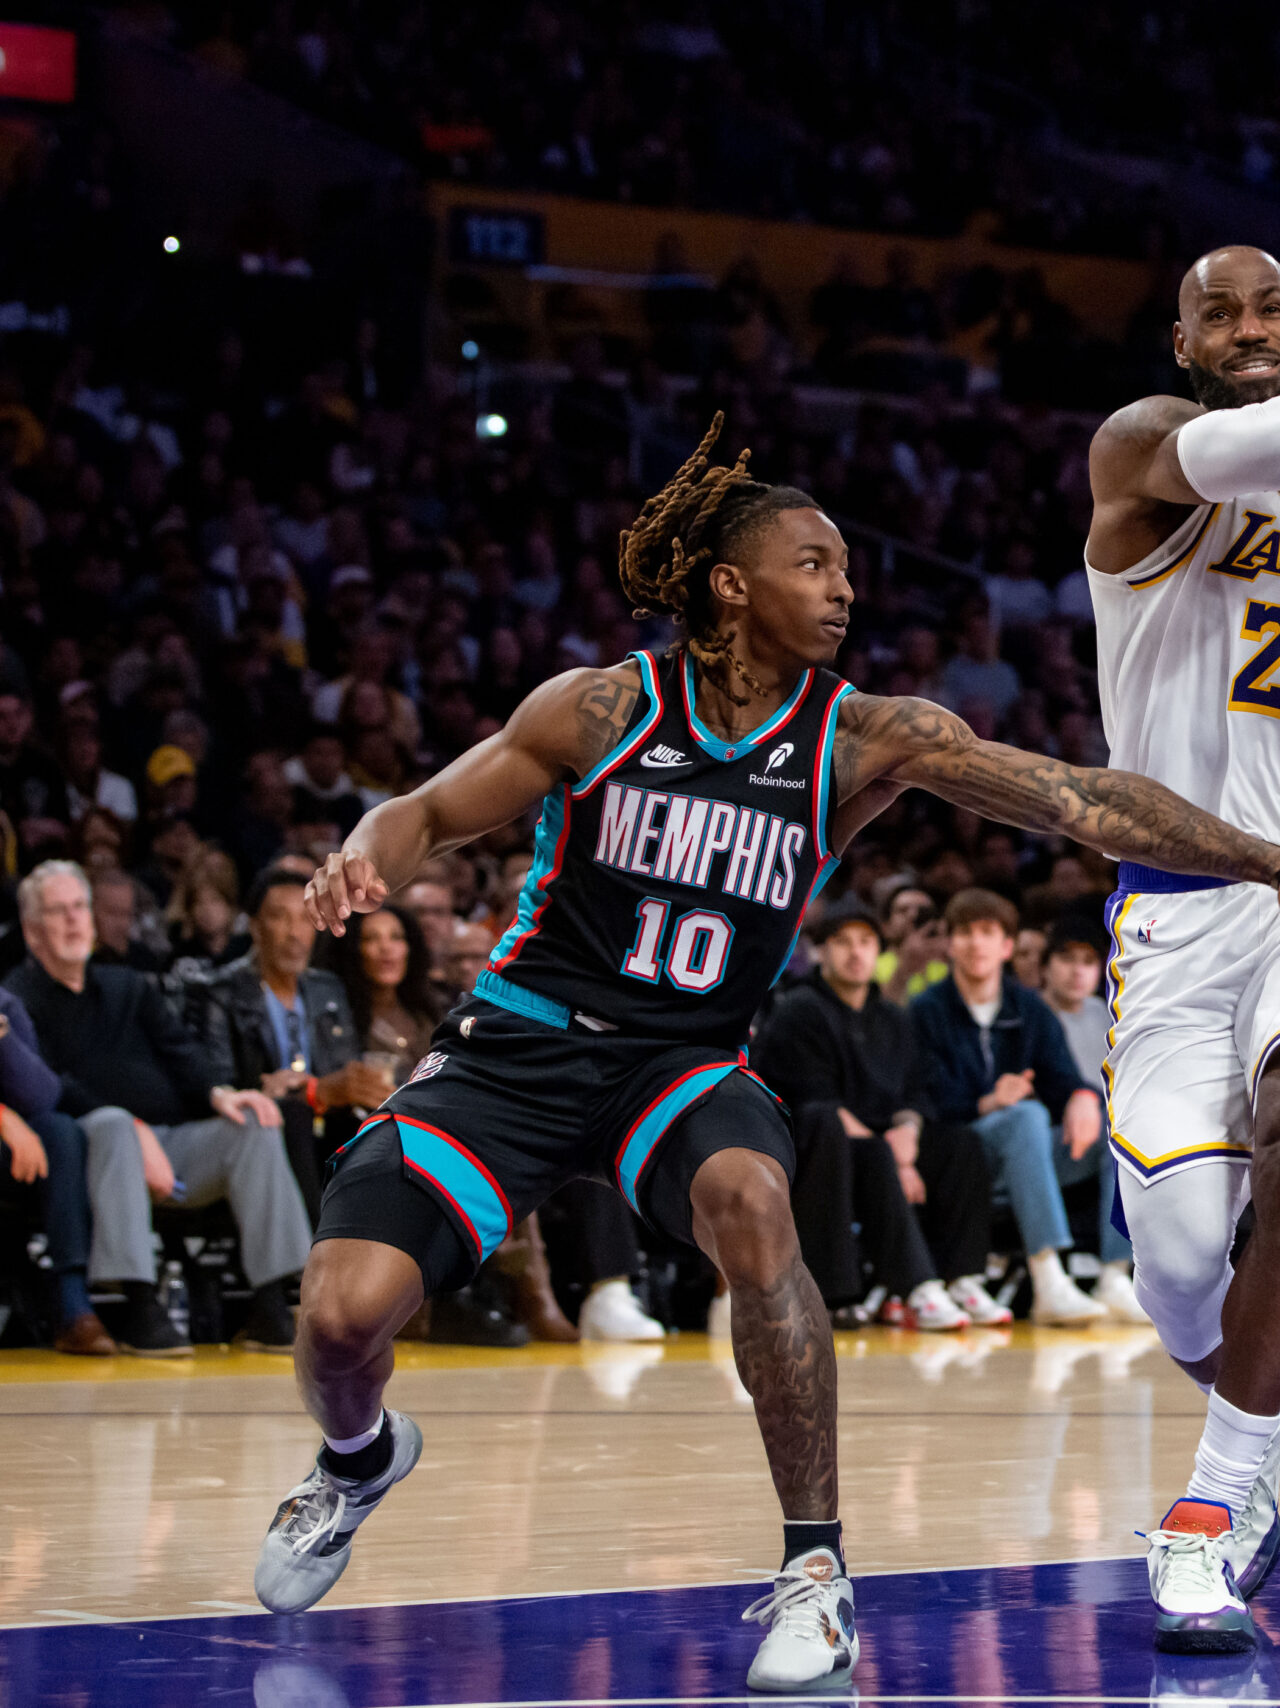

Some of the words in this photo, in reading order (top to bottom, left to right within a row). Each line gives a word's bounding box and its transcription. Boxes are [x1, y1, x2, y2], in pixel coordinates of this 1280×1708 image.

[649, 743, 686, 765] NIKE
[749, 774, 806, 789] Robinhood
[593, 780, 808, 910] MEMPHIS
[620, 896, 737, 995] 10
